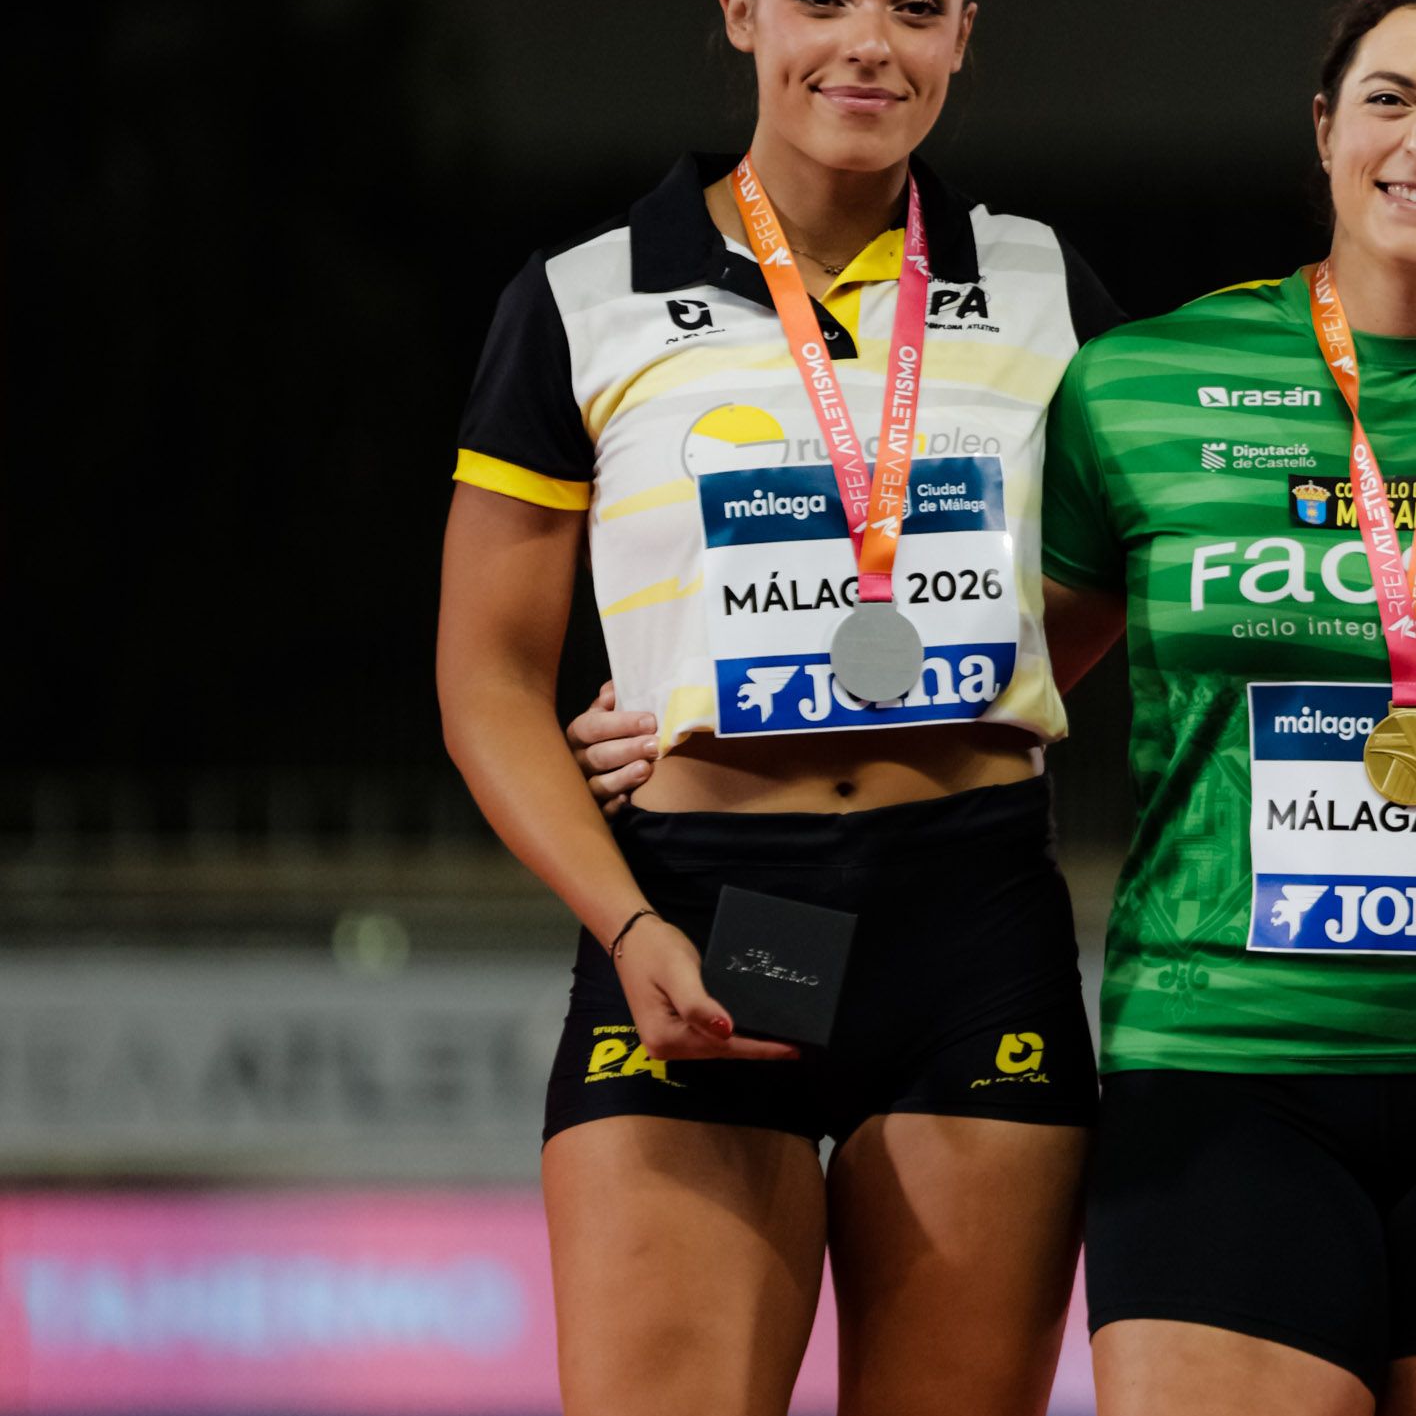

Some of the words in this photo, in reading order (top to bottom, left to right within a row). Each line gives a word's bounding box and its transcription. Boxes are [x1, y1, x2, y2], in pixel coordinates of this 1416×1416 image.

[801, 341, 858, 456] ATLETISMO
[887, 345, 919, 455] ATLETISMO
[1231, 386, 1321, 407] rasán
[1232, 443, 1310, 460] Diputació
[1232, 458, 1252, 469] de
[1254, 456, 1317, 469] Castelló
[917, 483, 967, 497] Ciudad
[1353, 443, 1396, 555] ATLETISMO
[918, 499, 937, 513] de
[939, 498, 986, 513] Málaga
[723, 571, 860, 616] MÁLAG
[906, 569, 1003, 604] 2026
[1381, 559, 1407, 616] RFEA
[1232, 616, 1296, 638] ciclo
